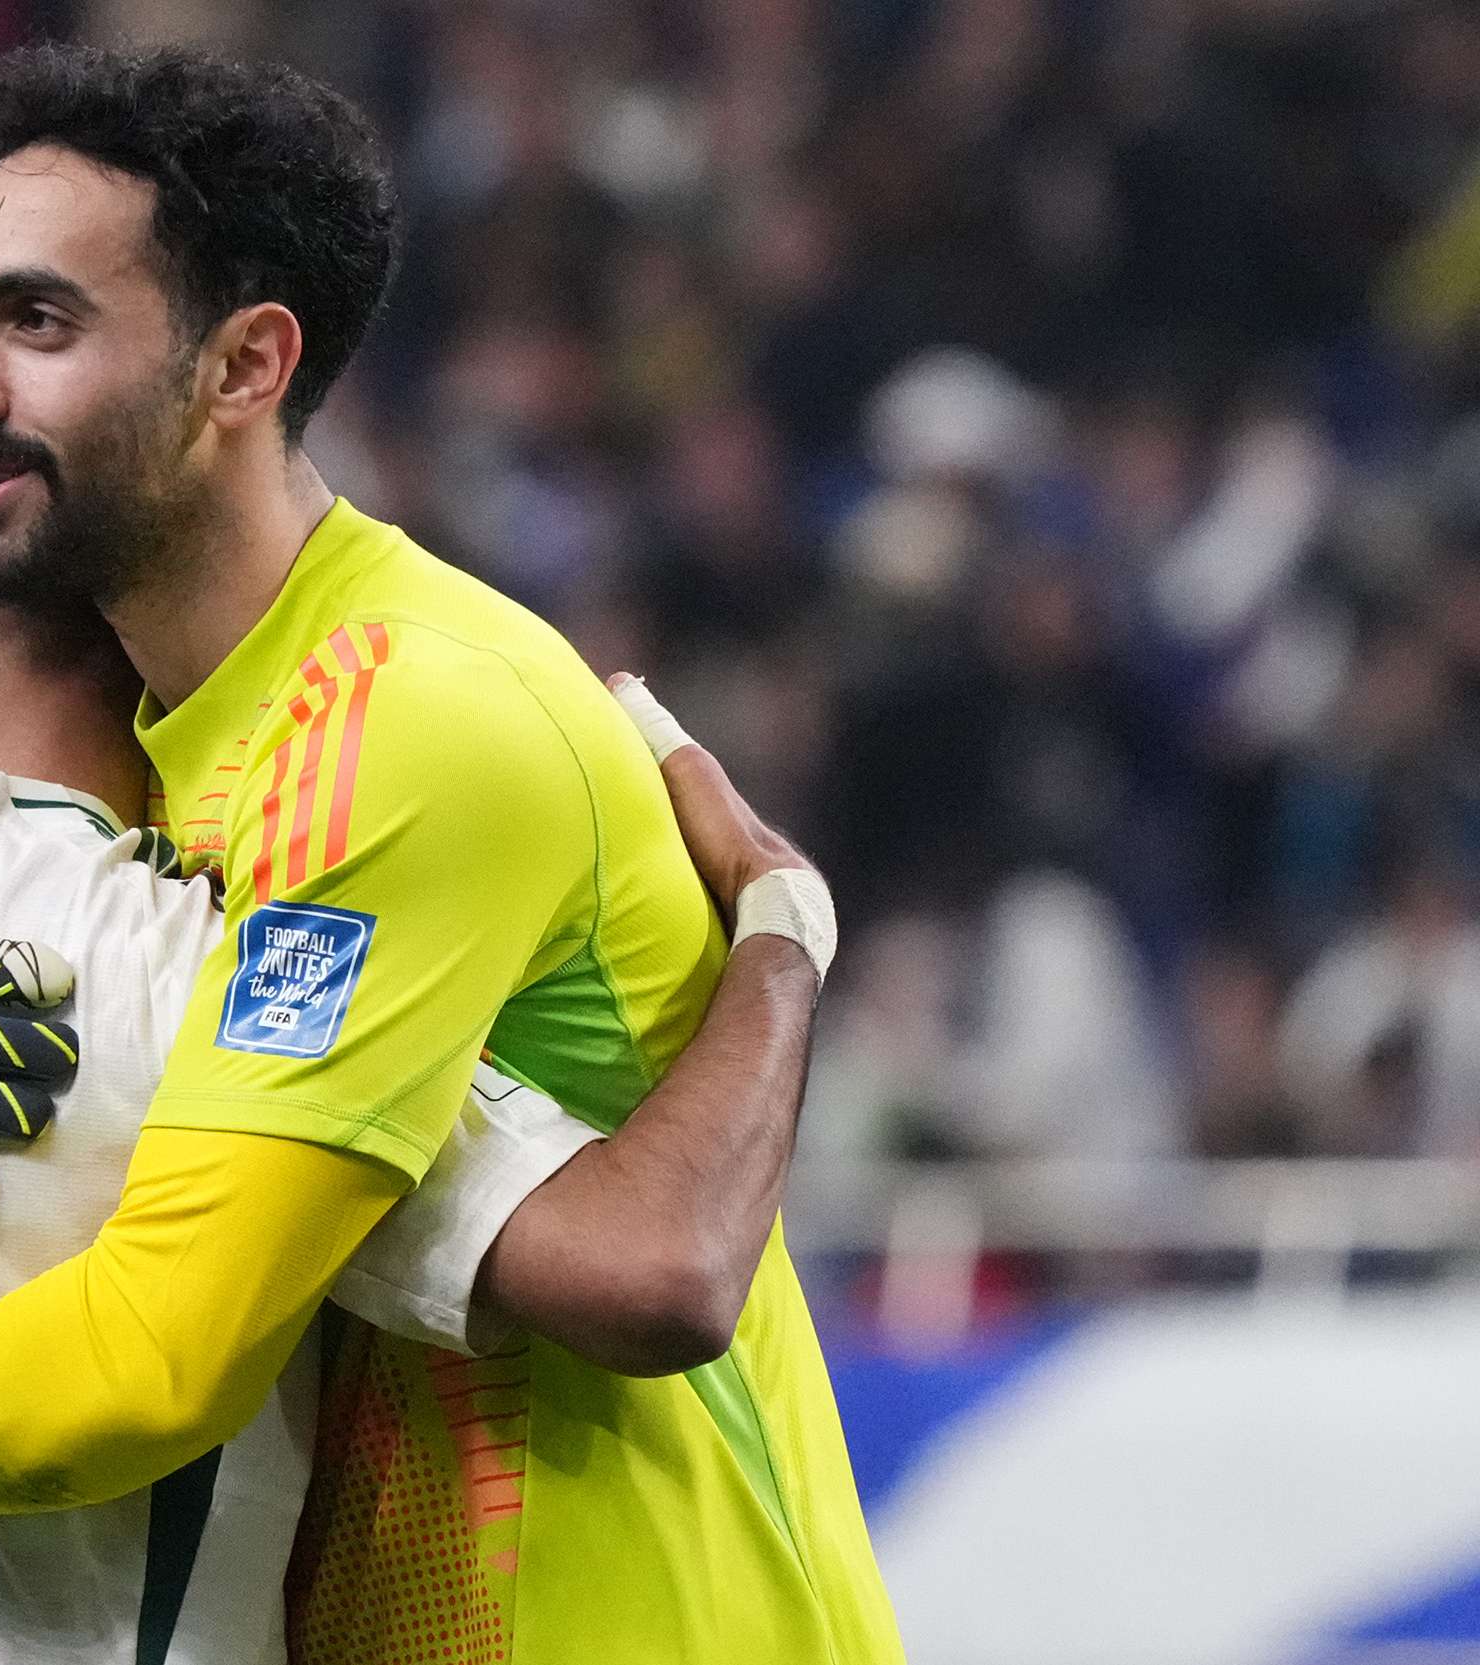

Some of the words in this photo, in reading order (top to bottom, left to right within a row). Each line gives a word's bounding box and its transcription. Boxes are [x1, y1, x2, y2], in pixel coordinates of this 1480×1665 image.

[265, 926, 336, 956] FOOTBALL
[257, 947, 334, 982] UNITES
[248, 975, 277, 998] the
[275, 979, 328, 1009] World
[264, 1011, 291, 1024] FIFA
